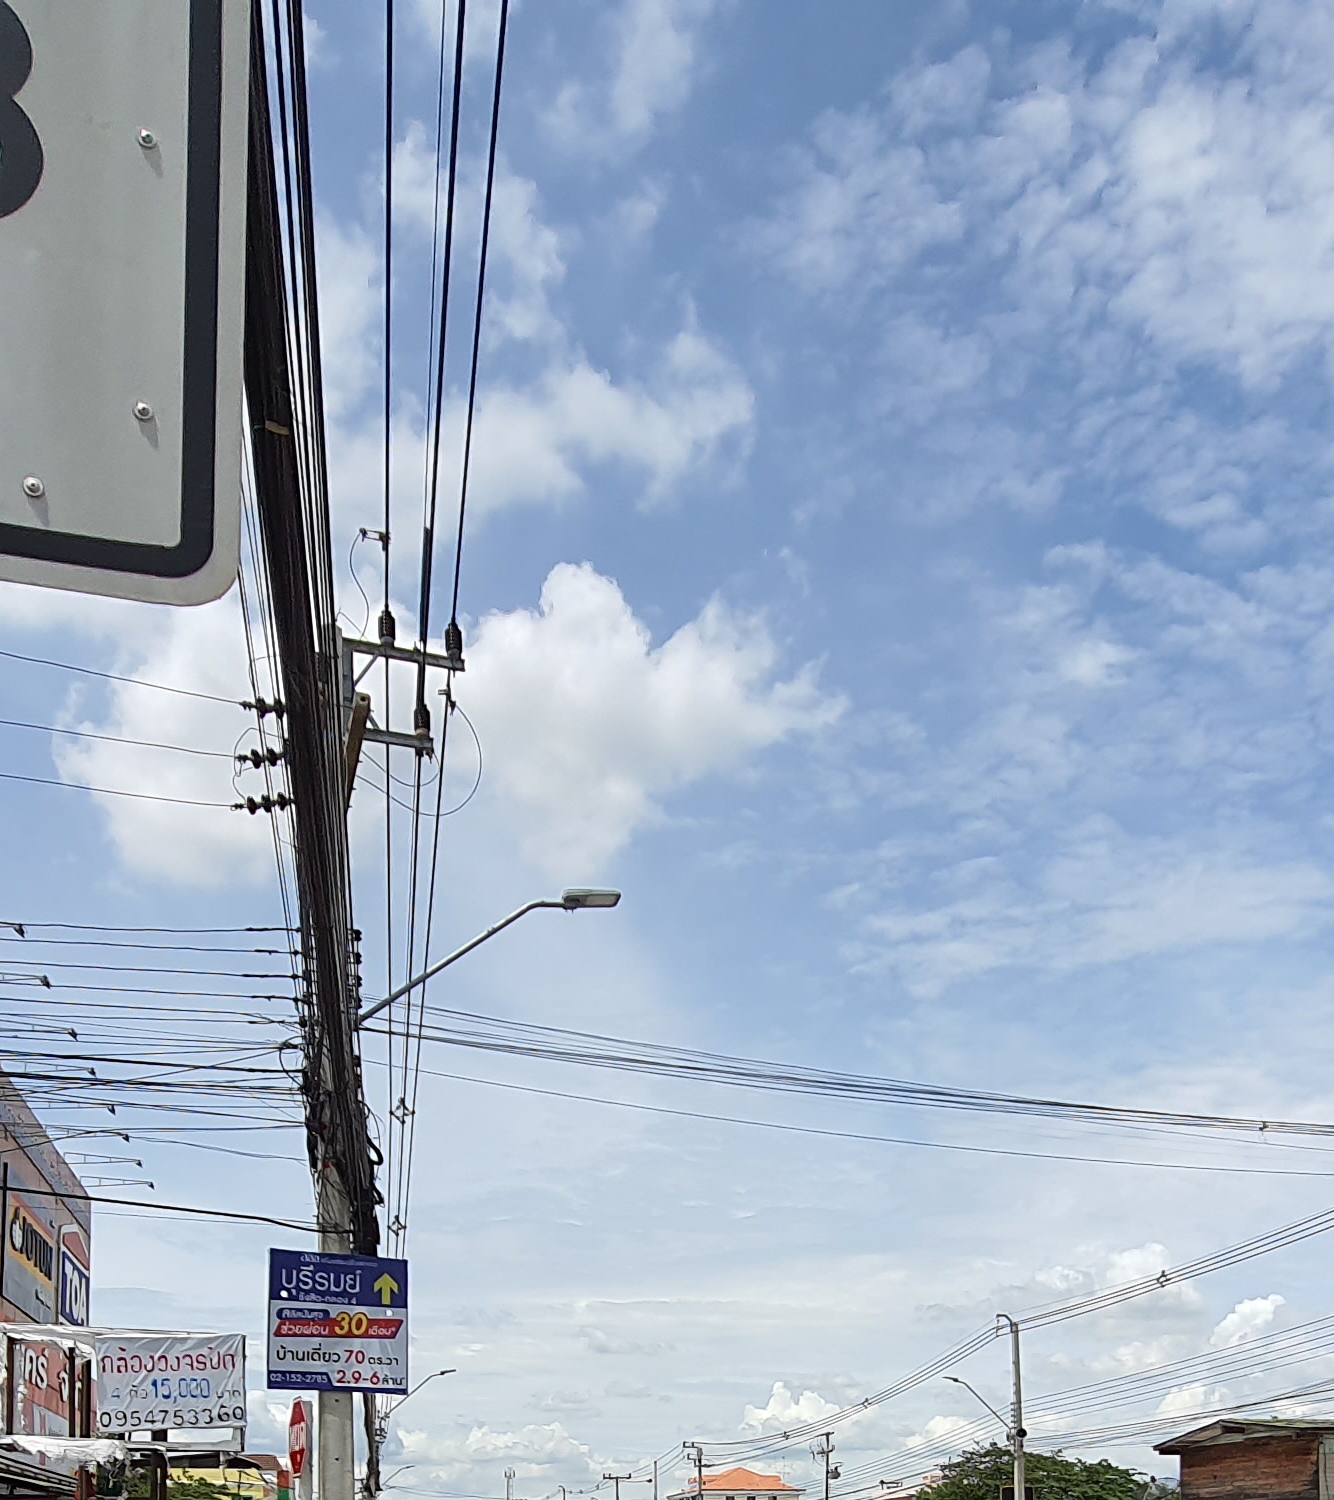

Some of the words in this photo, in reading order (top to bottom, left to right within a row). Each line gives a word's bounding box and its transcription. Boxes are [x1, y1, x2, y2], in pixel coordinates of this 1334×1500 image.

[20, 1215, 53, 1281] JOTUN
[63, 1263, 86, 1322] TOA
[281, 1264, 362, 1296] บุรีรมย์
[334, 1311, 368, 1335] 30
[100, 1346, 236, 1374] กล้องวงจรปิด
[276, 1343, 341, 1361] บ้านเดี่ยว
[344, 1350, 365, 1364] 70
[336, 1370, 380, 1385] 2.9-6
[151, 1378, 210, 1404] 15,000
[100, 1405, 244, 1428] 0954753360
